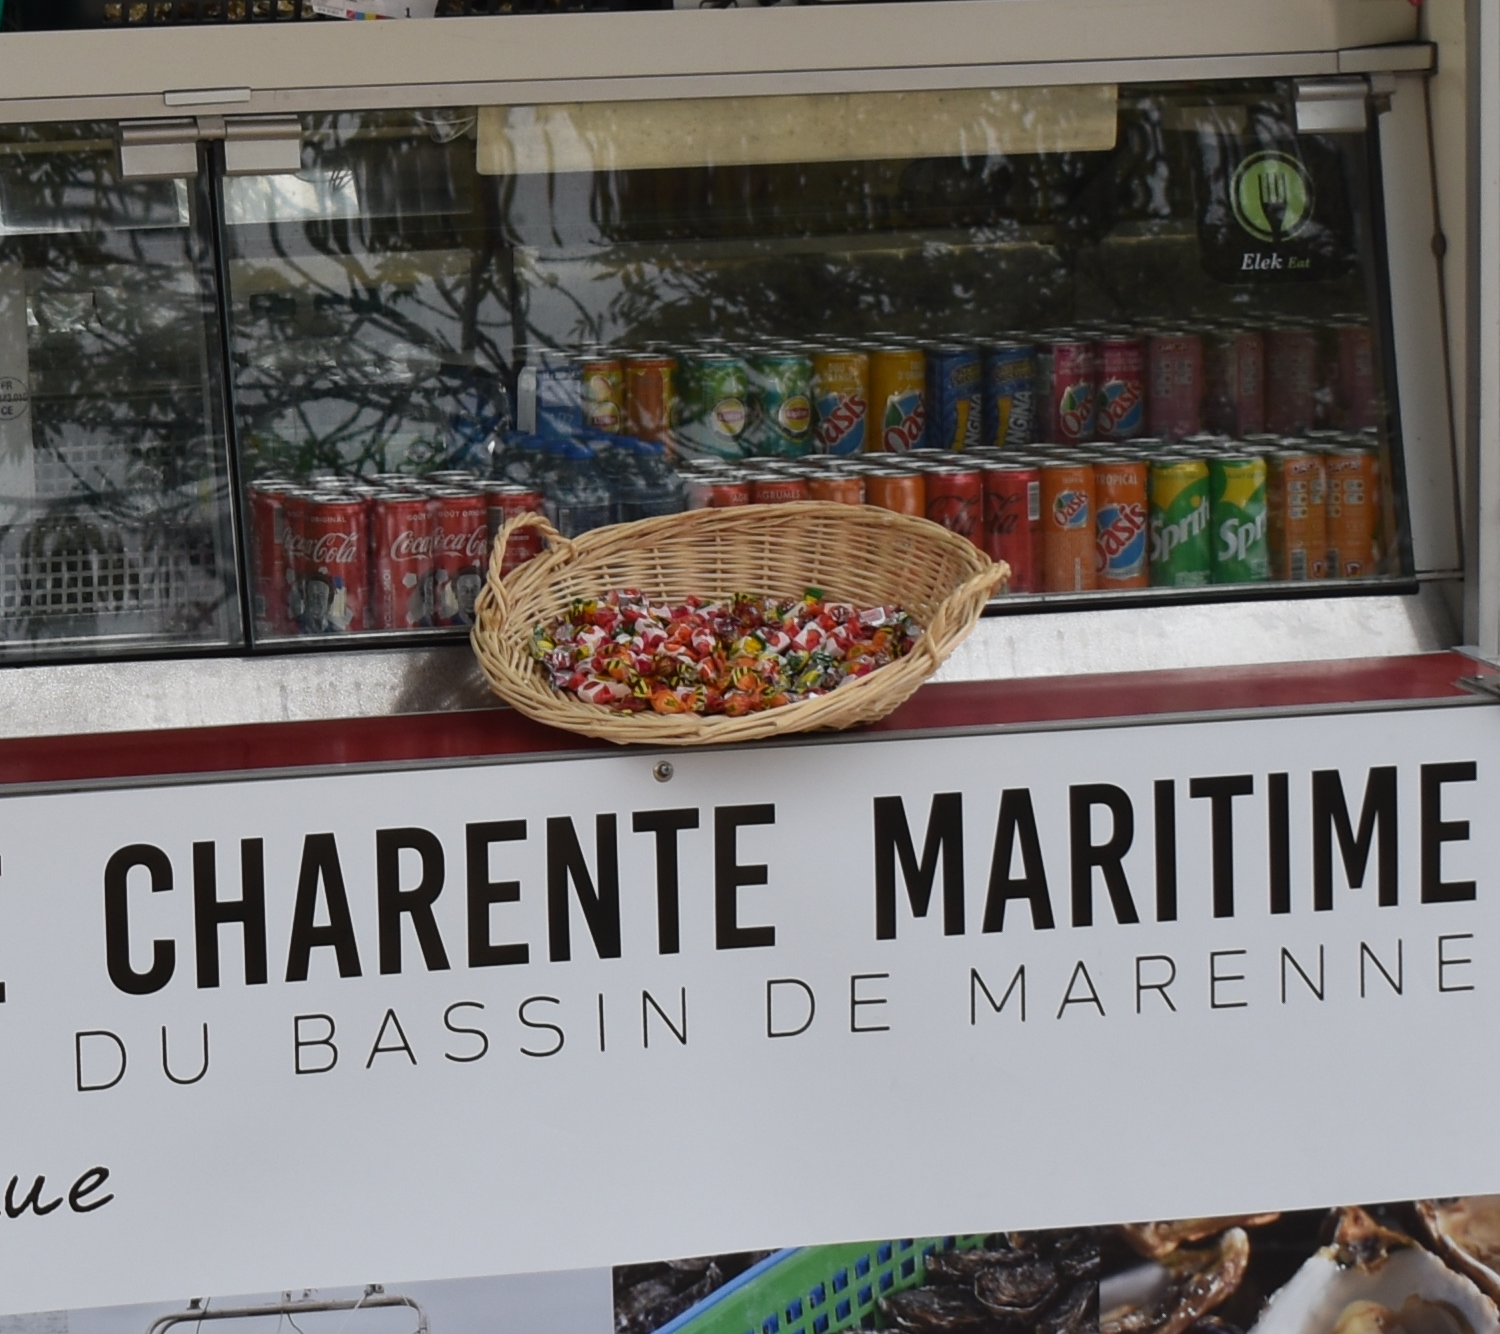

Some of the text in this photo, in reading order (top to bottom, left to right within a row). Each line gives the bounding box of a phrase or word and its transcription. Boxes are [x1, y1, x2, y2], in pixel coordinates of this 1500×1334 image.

[1241, 253, 1282, 271] Elek
[1, 380, 13, 391] FR
[1, 405, 14, 416] CE
[103, 804, 777, 996] CHARENTE
[874, 760, 1478, 941] MARITIME
[75, 1021, 211, 1093] DU
[294, 986, 688, 1077] BASSIN
[767, 973, 891, 1039] DE
[969, 932, 1477, 1027] MARENNE
